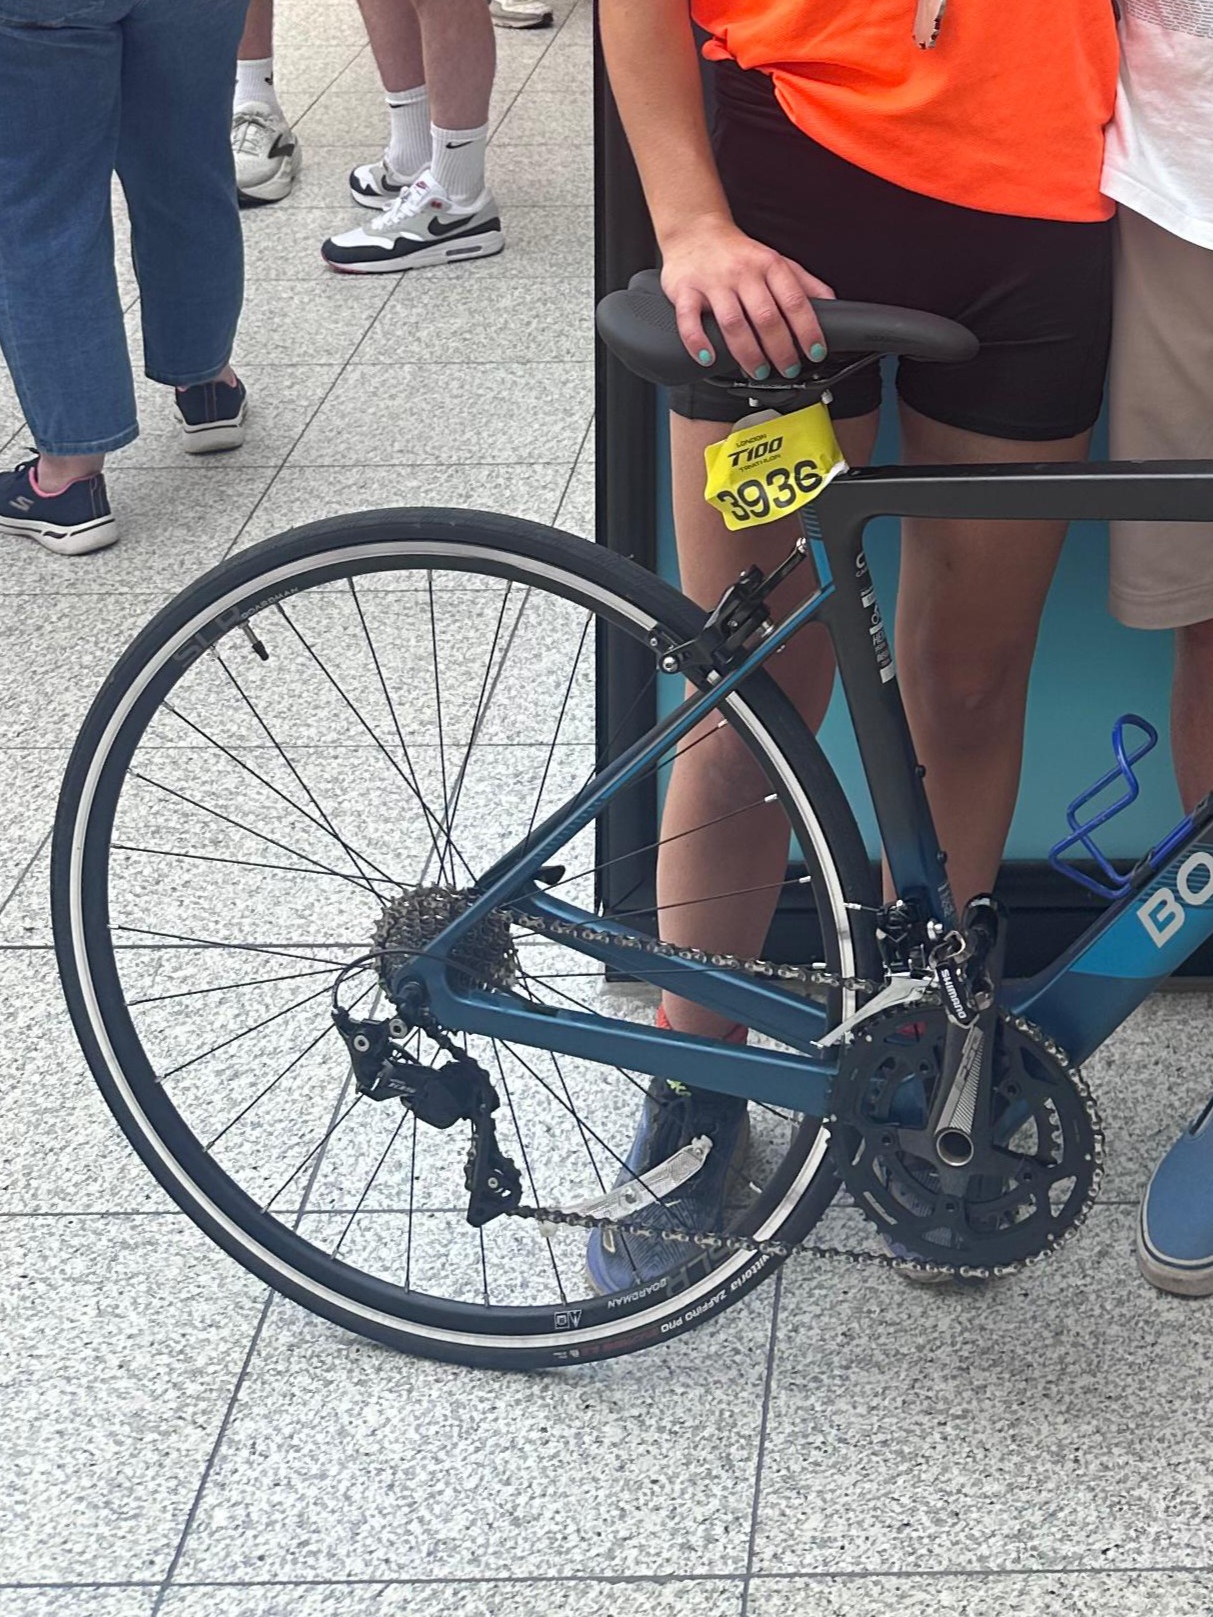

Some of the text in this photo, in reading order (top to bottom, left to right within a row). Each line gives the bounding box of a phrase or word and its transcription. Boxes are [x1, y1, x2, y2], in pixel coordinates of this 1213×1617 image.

[727, 436, 784, 468] T100
[735, 433, 768, 448] LONDON
[716, 459, 823, 521] 3936
[940, 968, 967, 1020] SHIMANO
[606, 1276, 668, 1309] BOARDMAN
[660, 1253, 771, 1333] vittoria ZAFFIRO PRO
